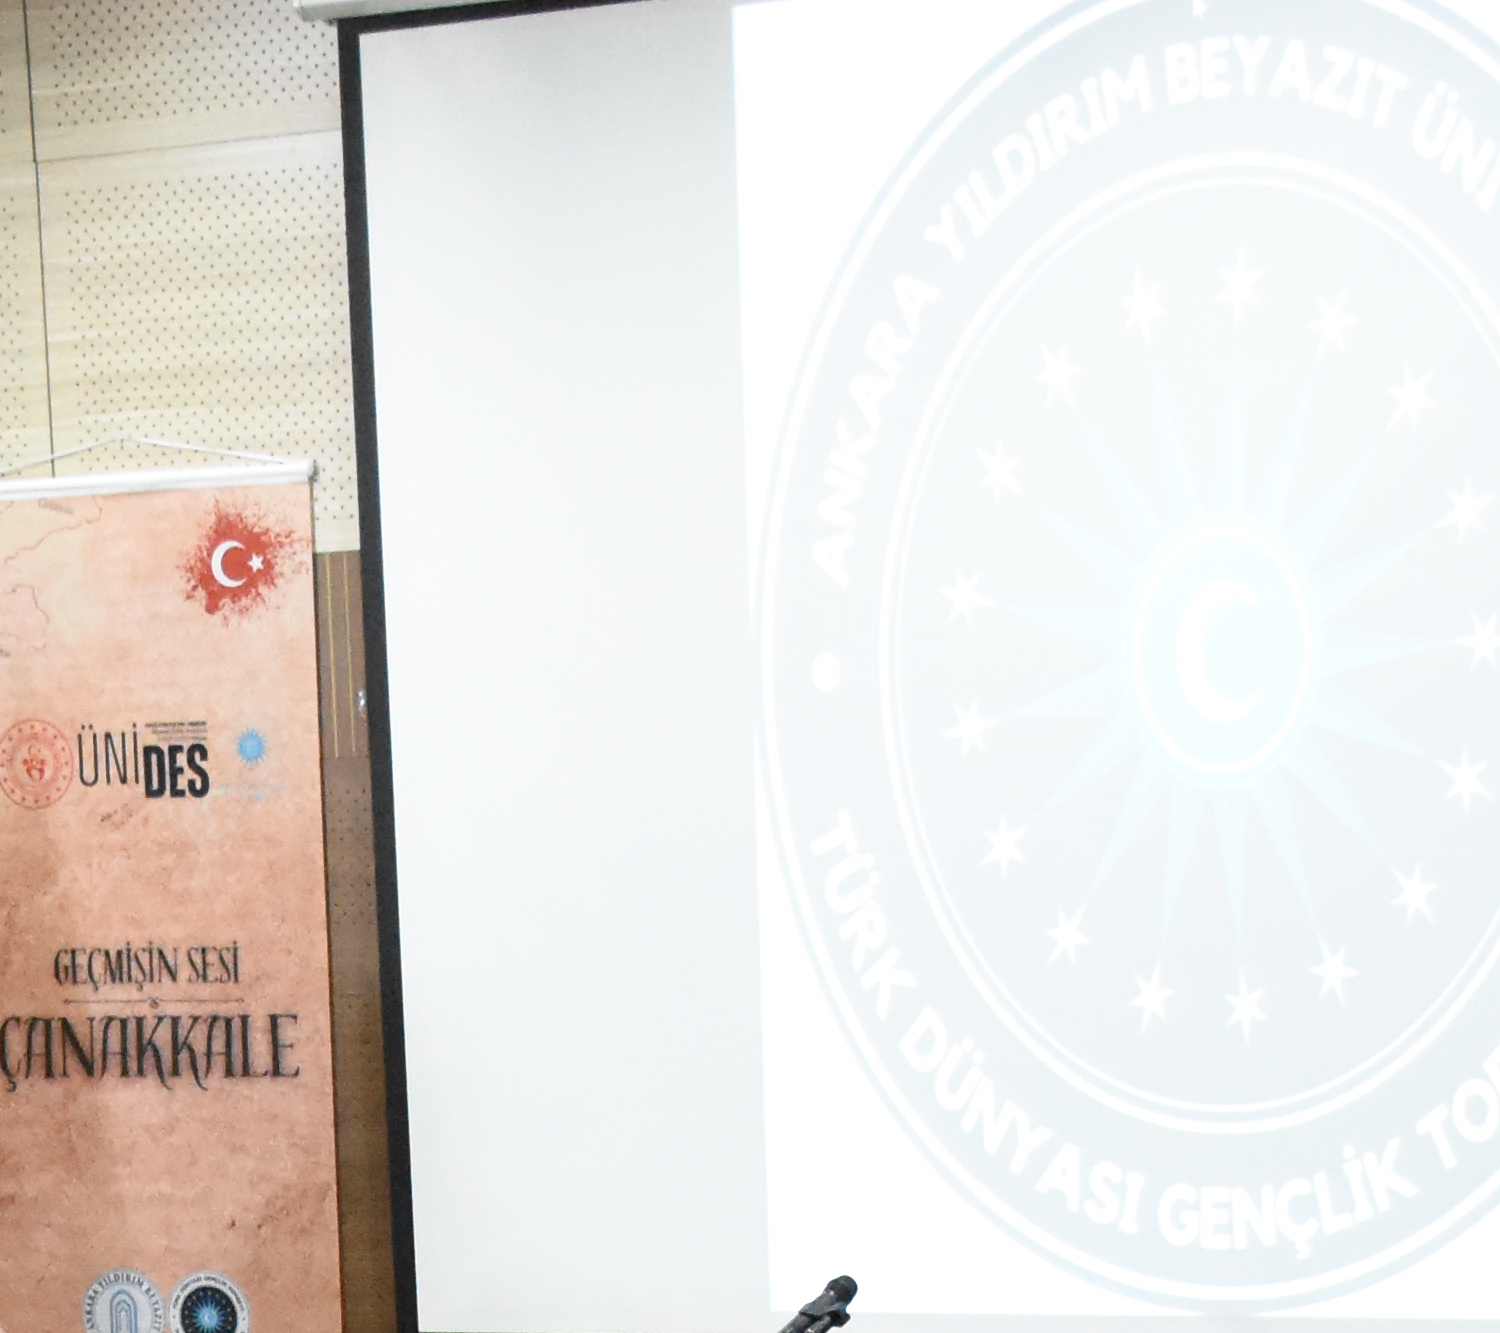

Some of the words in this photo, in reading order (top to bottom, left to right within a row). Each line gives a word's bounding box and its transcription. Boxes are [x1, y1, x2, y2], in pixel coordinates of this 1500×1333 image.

[810, 273, 940, 588] ANKARA
[924, 55, 1155, 264] YILDIRIM
[1164, 35, 1409, 128] BEYAZIT
[53, 940, 179, 992] GEÇMİŞİN
[187, 939, 241, 984] SESİ
[809, 807, 919, 1022] TÜRK
[898, 1006, 1147, 1237] DÜNYASI
[1156, 1142, 1420, 1261] GENÇLİK
